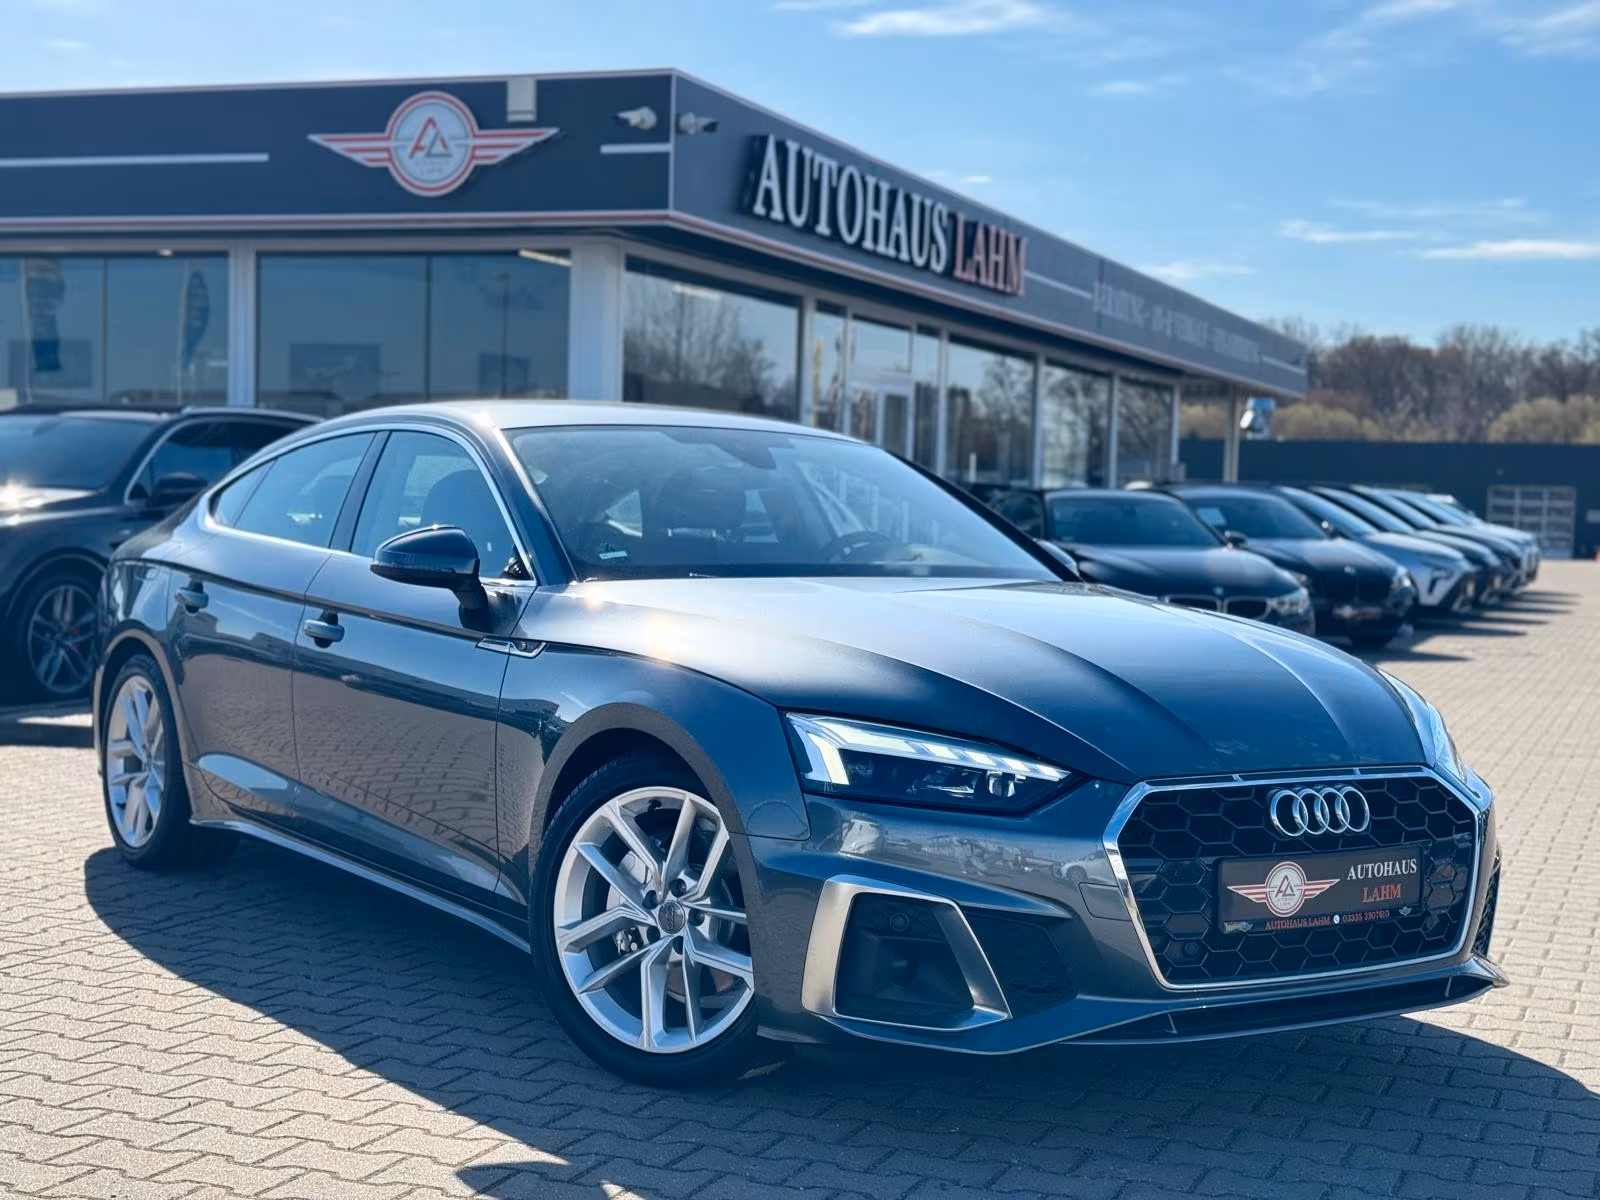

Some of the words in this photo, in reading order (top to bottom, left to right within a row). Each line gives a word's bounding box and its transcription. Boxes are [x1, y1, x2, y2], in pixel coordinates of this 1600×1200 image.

[752, 132, 950, 274] AUTOHAUS
[952, 210, 1028, 297] LAHM
[1346, 858, 1417, 880] AUTOHAUS
[1362, 884, 1402, 903] LAHM
[1264, 918, 1308, 931] AUTOHAUS
[1308, 915, 1331, 927] LAHM
